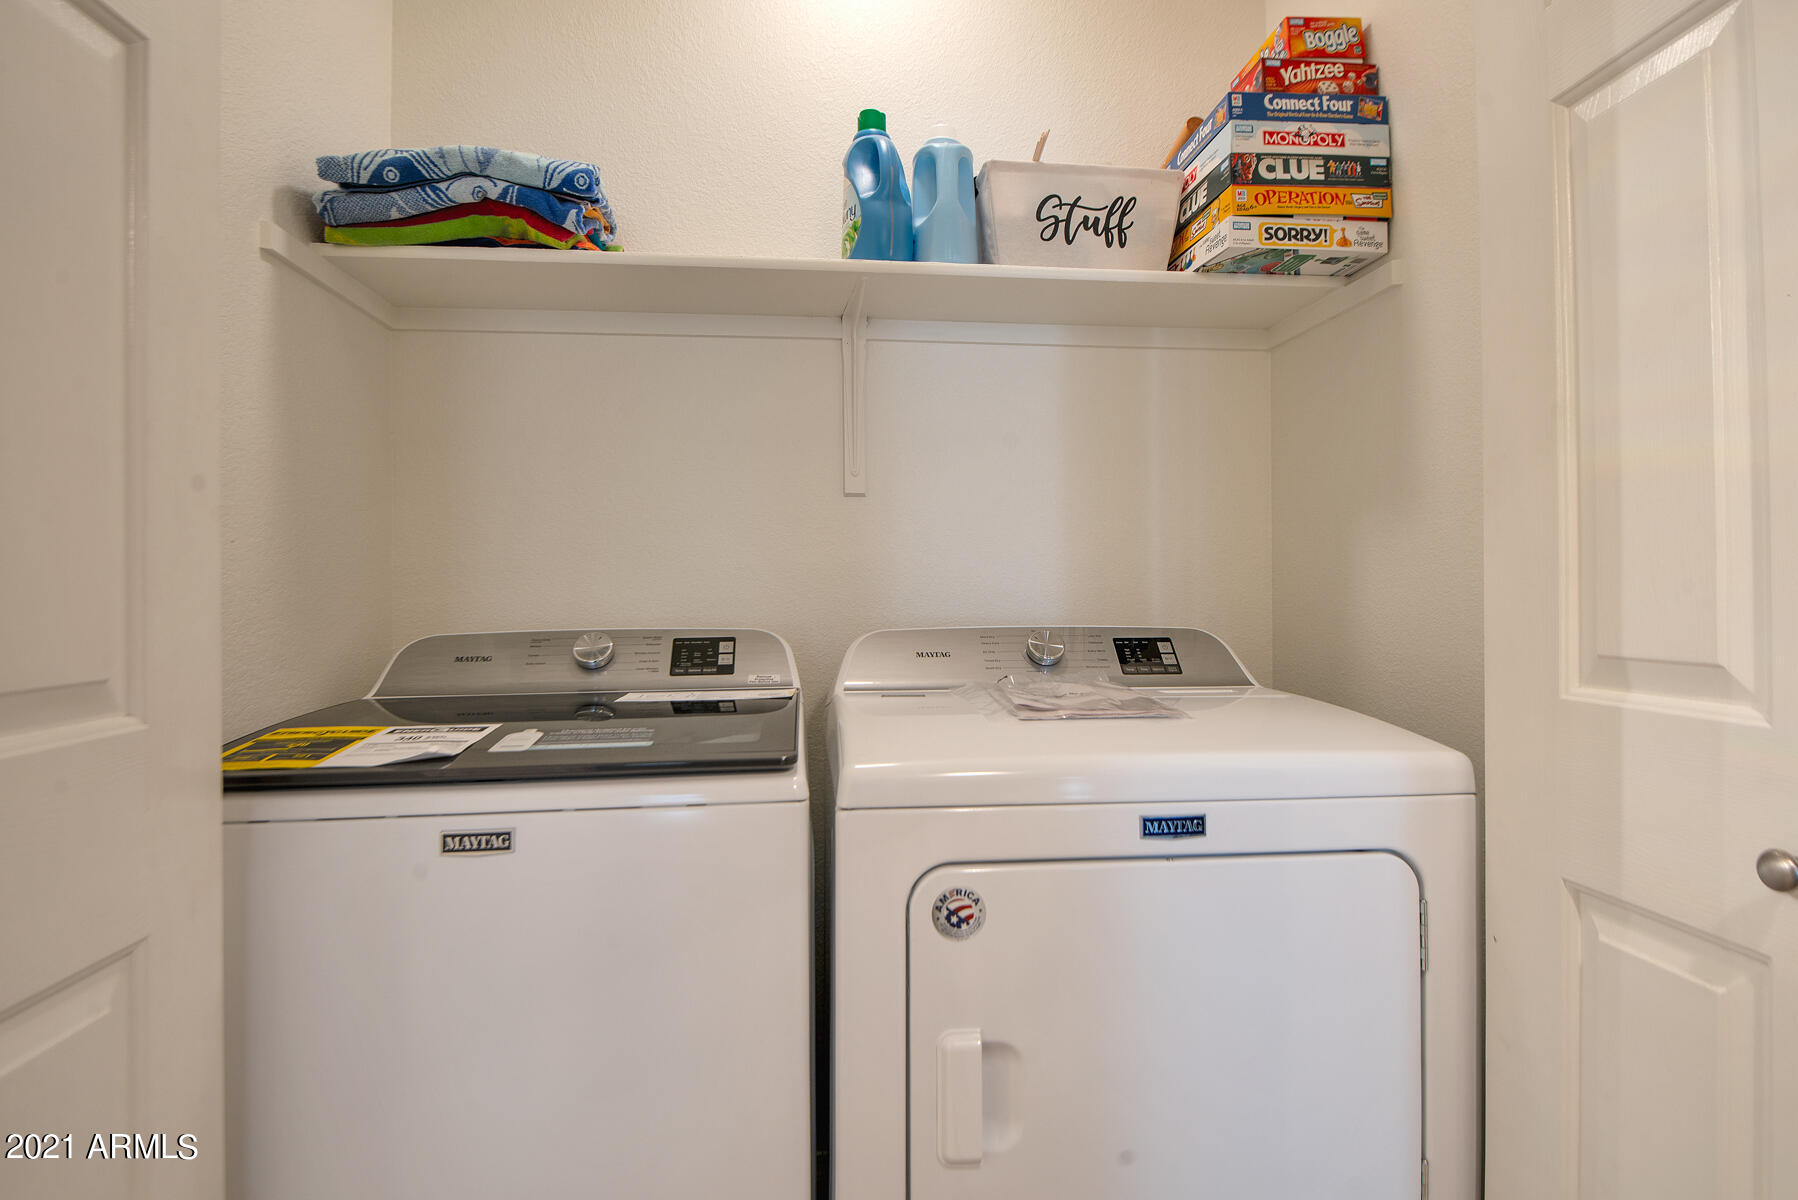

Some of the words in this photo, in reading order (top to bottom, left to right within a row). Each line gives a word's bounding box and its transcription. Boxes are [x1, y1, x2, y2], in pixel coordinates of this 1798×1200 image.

[1303, 24, 1359, 52] Boggle
[1280, 63, 1345, 86] Yahtzee
[1264, 94, 1320, 111] Connect
[1322, 95, 1354, 112] Four
[1265, 132, 1344, 147] MONOPOLY
[1258, 157, 1325, 181] CLUE
[1179, 180, 1208, 224] CLUE
[1254, 189, 1346, 207] OPERATION
[1036, 194, 1137, 249] Stuff
[1264, 226, 1328, 243] SORRY!
[454, 655, 493, 663] MAYTAG
[916, 651, 951, 659] MAYTAG
[1144, 818, 1204, 836] MAYTAG
[443, 833, 511, 853] MAYTAG
[935, 888, 980, 912] AMERICA
